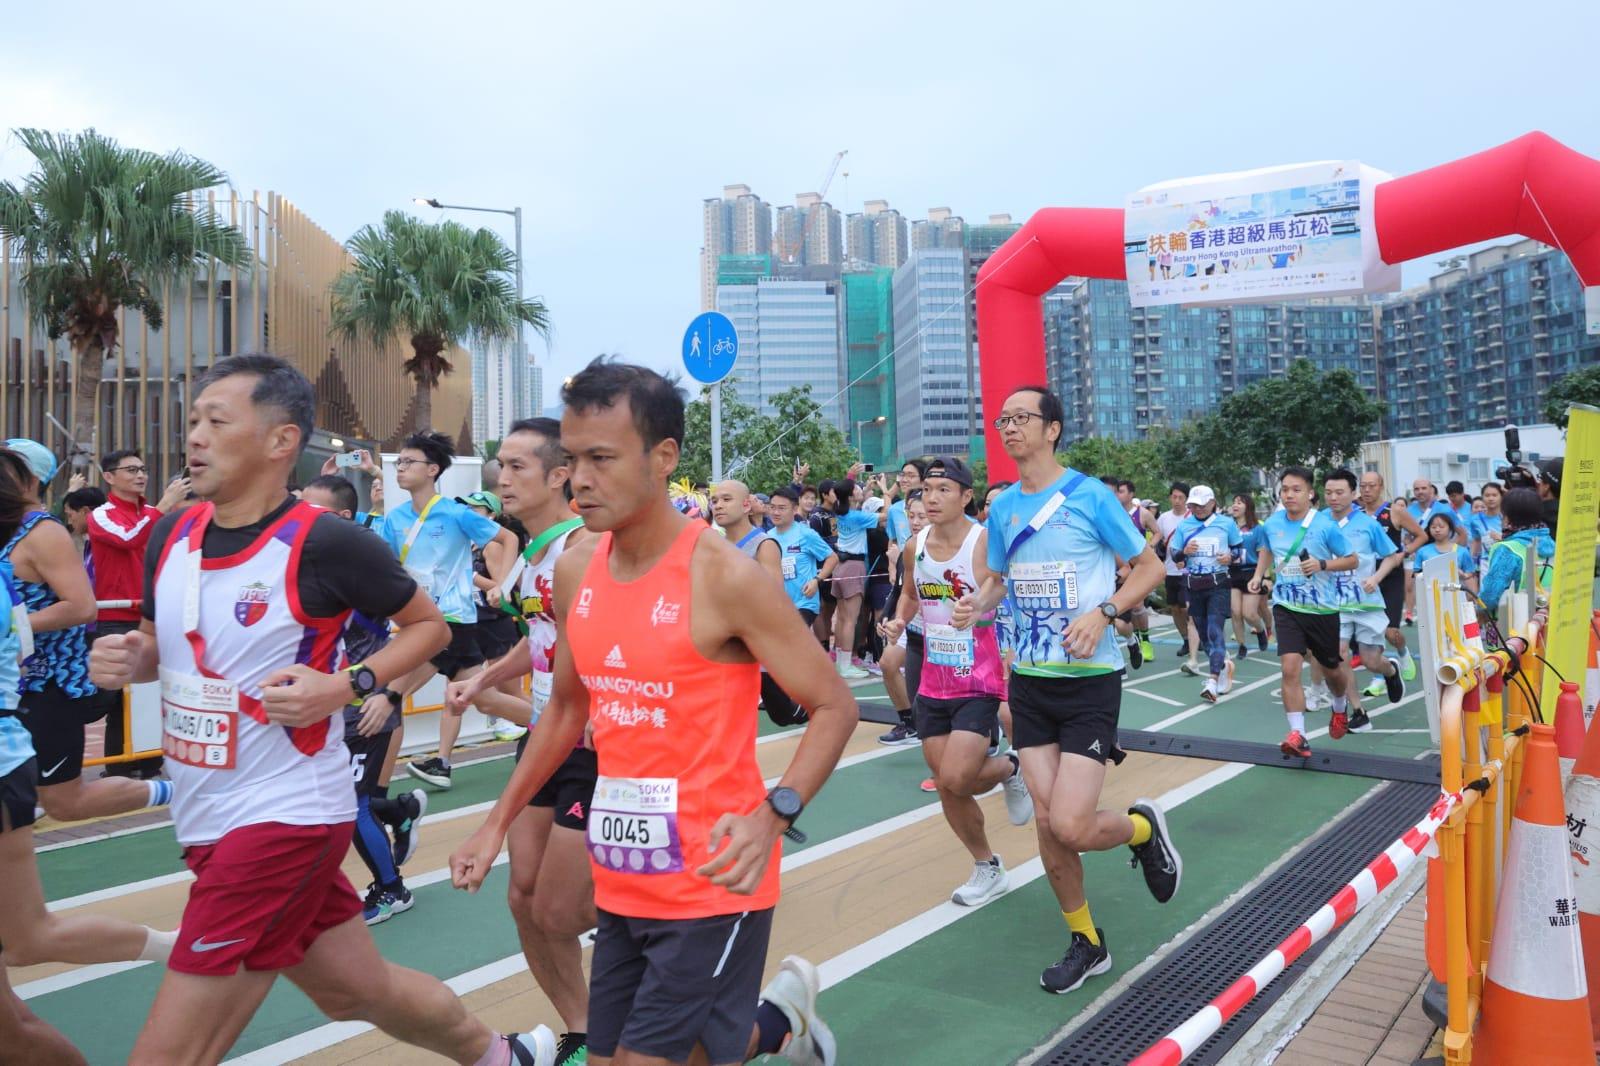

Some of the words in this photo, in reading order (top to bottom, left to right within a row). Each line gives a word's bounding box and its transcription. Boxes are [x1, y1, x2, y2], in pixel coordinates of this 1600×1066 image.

[1148, 216, 1330, 255] 扶輪香港超級馬拉松
[1198, 252, 1217, 260] Hong
[1220, 250, 1239, 258] Kong
[1241, 243, 1298, 255] Ultramarathon
[602, 816, 650, 845] 0045
[1548, 916, 1571, 927] WAH
